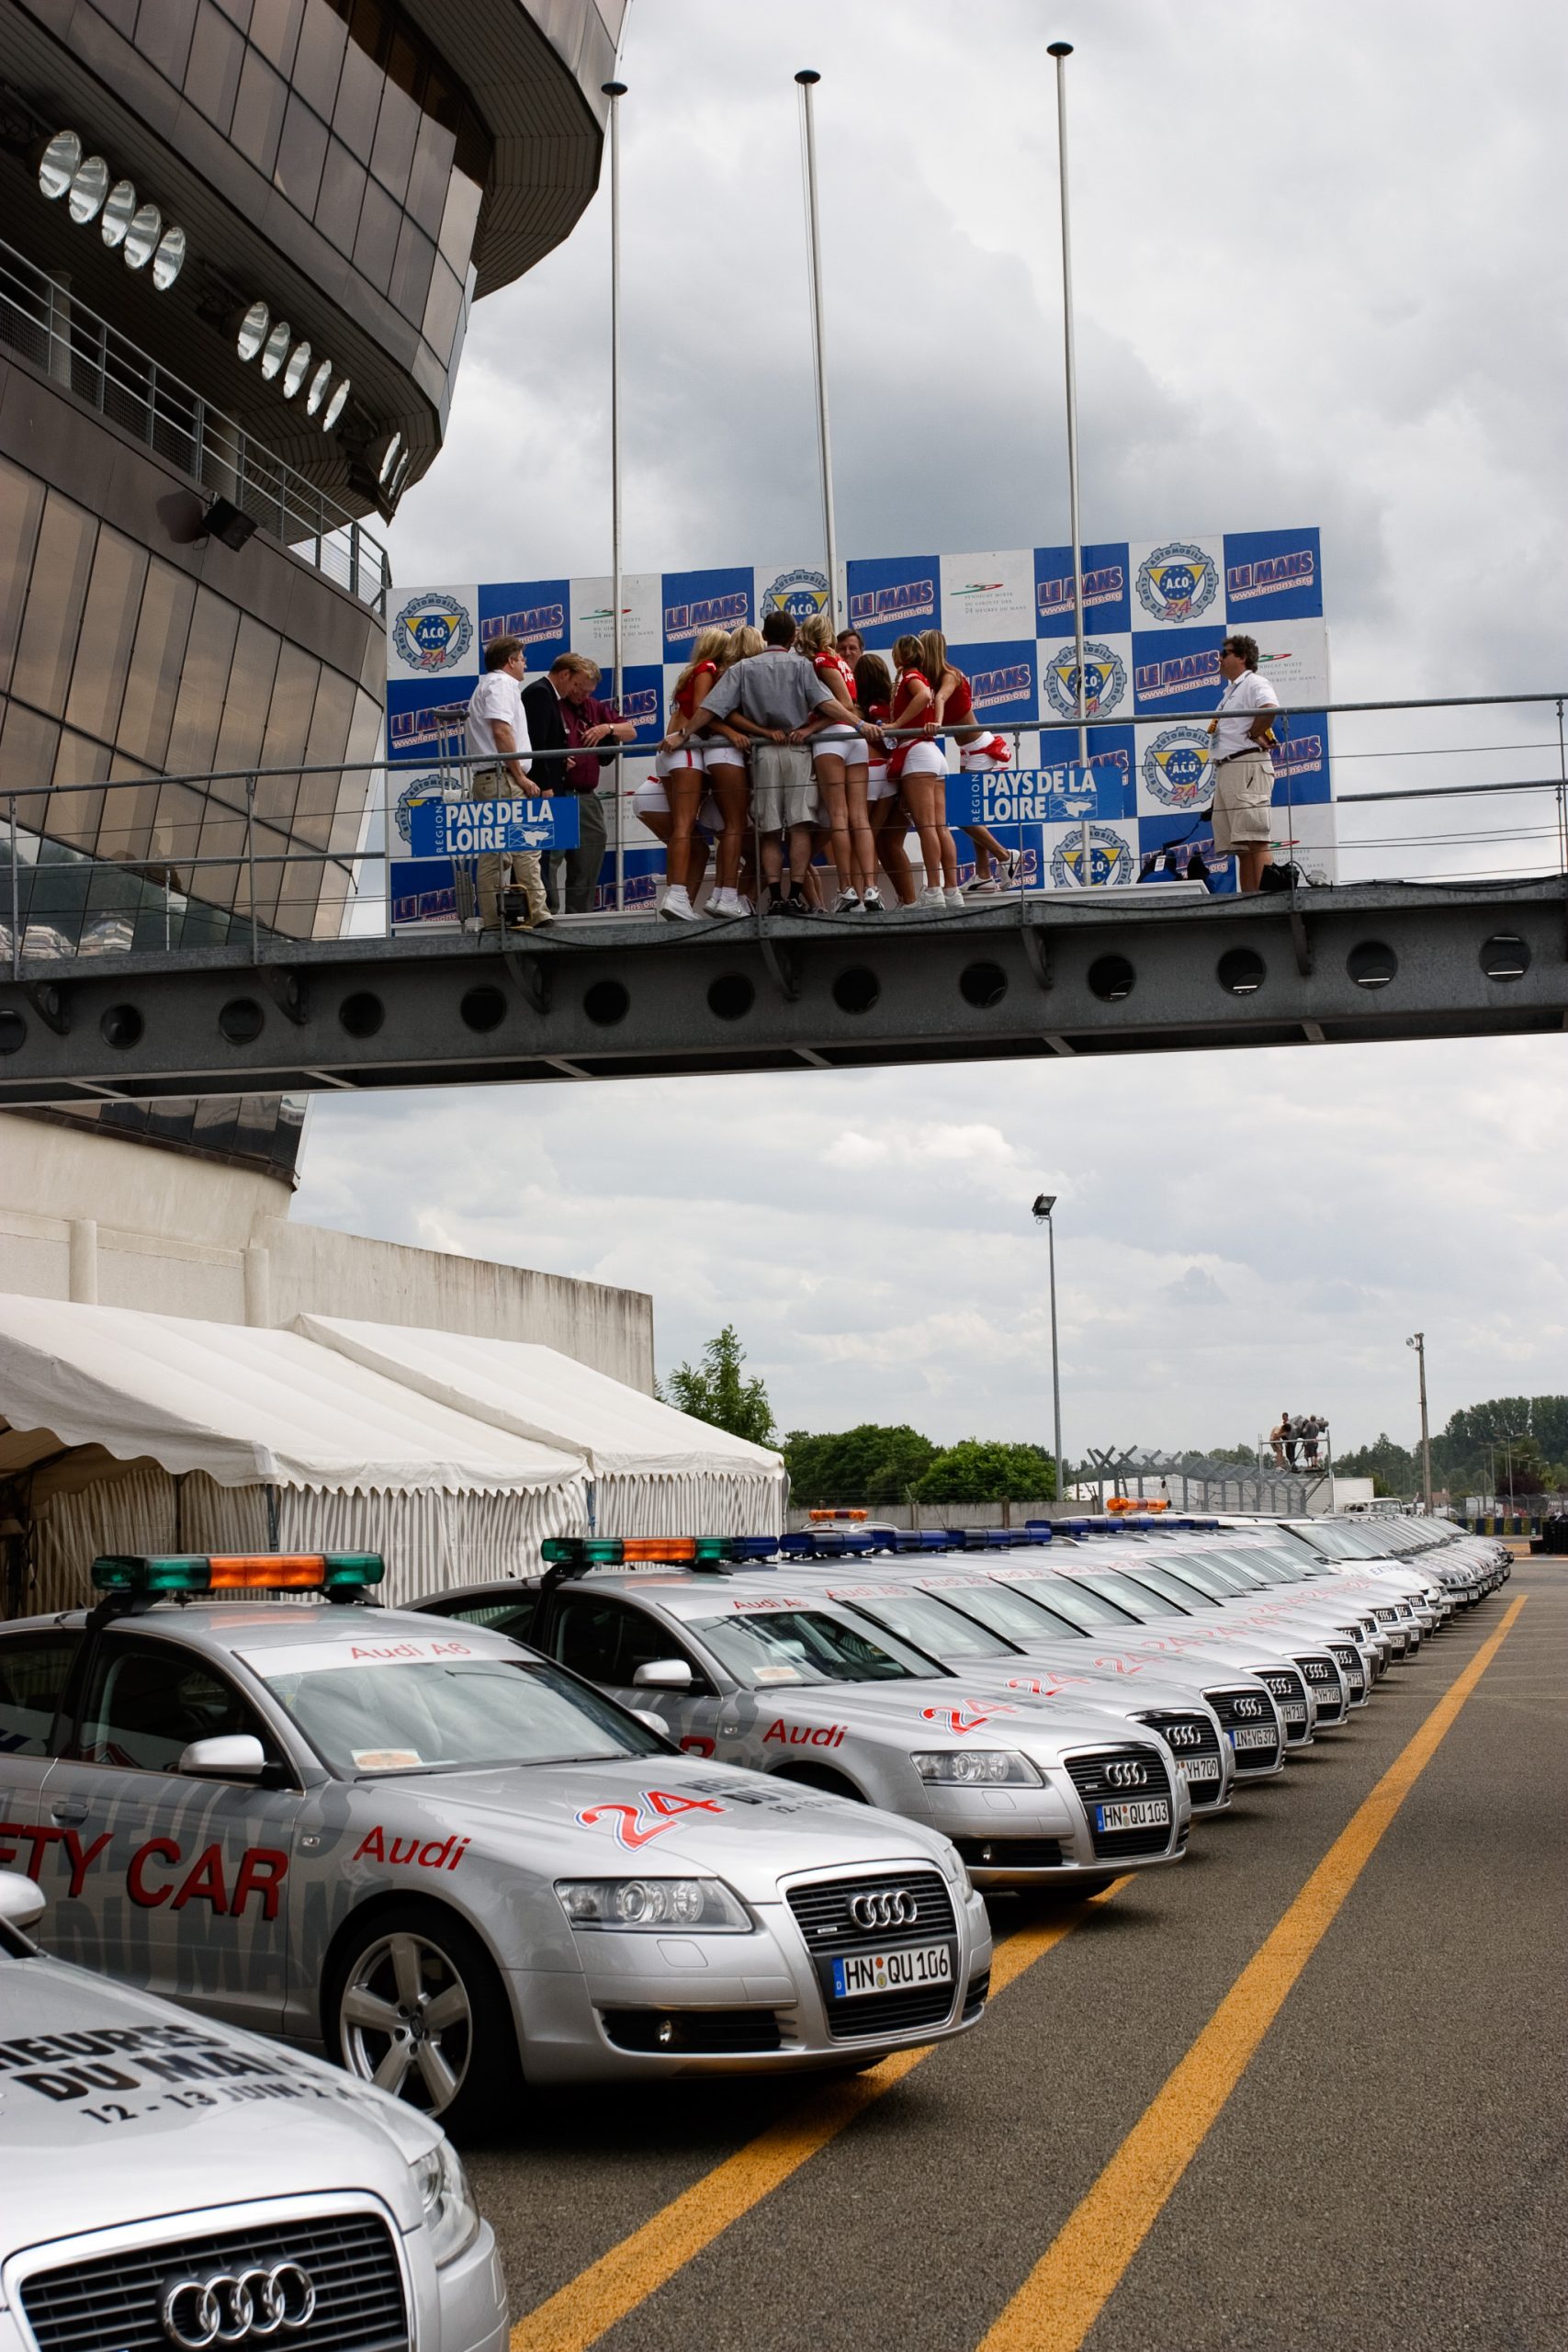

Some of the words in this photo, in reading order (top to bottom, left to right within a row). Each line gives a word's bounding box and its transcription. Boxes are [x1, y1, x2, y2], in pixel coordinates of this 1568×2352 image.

[1150, 548, 1203, 565] AUTOMOBILE
[1227, 564, 1252, 592] LE
[1253, 550, 1314, 585] MANS
[851, 593, 874, 618] LE
[875, 580, 934, 614] MANS
[1038, 580, 1062, 606] LE
[1141, 577, 1150, 602] CLUB
[1151, 604, 1162, 614] DE
[1229, 575, 1314, 603] www.lemans.org
[407, 598, 459, 616] AUTOMOBILE
[665, 605, 688, 632] LE
[690, 593, 748, 626] MANS
[852, 604, 933, 629] www.lemans.org
[1165, 599, 1191, 617] 24
[481, 616, 504, 642] LE
[506, 605, 564, 636] MANS
[398, 627, 406, 650] CLUB
[420, 648, 446, 666] 24
[1135, 663, 1160, 691] LE
[1161, 650, 1221, 685] MANS
[972, 663, 1031, 698] MANS
[1050, 676, 1058, 699] CLUB
[1059, 703, 1070, 712] DE
[1137, 674, 1221, 701] www.lemans.org
[391, 712, 414, 738] LE
[983, 772, 1033, 796] PAYS
[1037, 770, 1065, 794] DE
[1069, 769, 1097, 793] LA
[1171, 785, 1198, 801] 24
[971, 774, 980, 823] RÉGION
[983, 797, 1047, 821] LOIRE
[446, 803, 494, 827] PAYS
[497, 801, 524, 824] DE
[527, 799, 554, 822] LA
[435, 806, 444, 853] RÉGION
[446, 827, 505, 852] LOIRE
[733, 1599, 781, 1610] Audi
[783, 1599, 810, 1609] A6
[827, 1586, 876, 1599] Audi
[880, 1587, 908, 1597] A6
[351, 1644, 424, 1659] Audi
[427, 1641, 471, 1656] A6
[1093, 1653, 1165, 1676] 24
[1004, 1672, 1093, 1697] 24
[919, 1698, 1021, 1736] 24
[762, 1719, 849, 1747] Audi
[1235, 1734, 1248, 1746] IN
[1252, 1730, 1264, 1744] YG
[1263, 1728, 1277, 1745] 372
[1186, 1764, 1201, 1779] YH
[1201, 1759, 1217, 1777] 709
[574, 1791, 734, 1852] 24
[1103, 1810, 1122, 1827] HN
[1129, 1806, 1146, 1824] QU
[1147, 1801, 1168, 1823] 103
[353, 1826, 471, 1871] Audi
[126, 1838, 289, 1921] CAR
[845, 1958, 874, 1990] HN
[887, 1952, 914, 1984] QU
[917, 1949, 948, 1981] 106
[10, 2063, 141, 2102] DU
[79, 2104, 139, 2125] 12
[163, 2090, 219, 2109] 13
